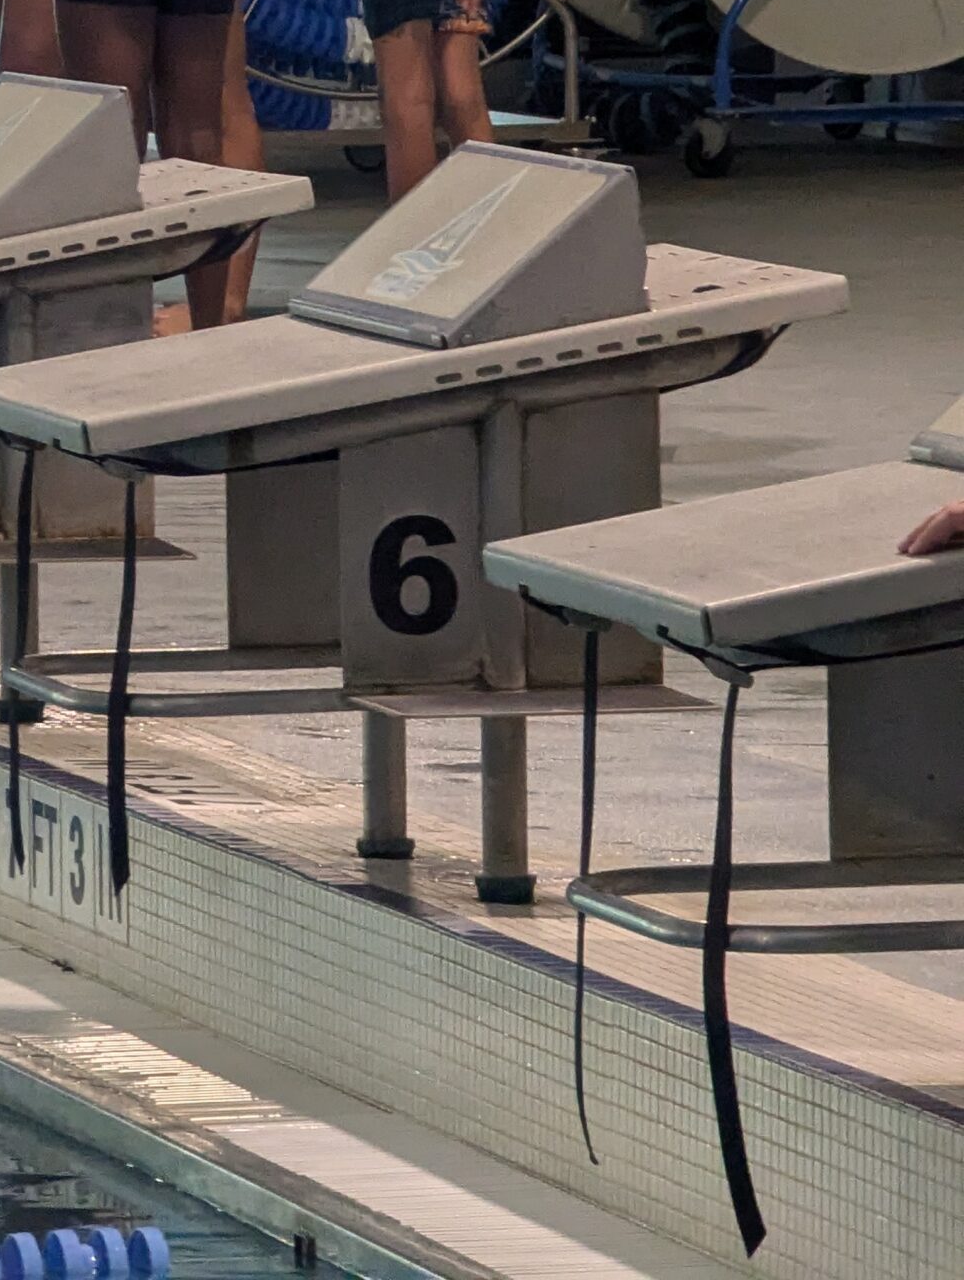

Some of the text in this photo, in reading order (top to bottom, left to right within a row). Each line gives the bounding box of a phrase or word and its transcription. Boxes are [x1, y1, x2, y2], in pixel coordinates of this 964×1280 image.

[369, 514, 458, 635] 6
[32, 799, 58, 897] FT
[69, 815, 85, 906] 3
